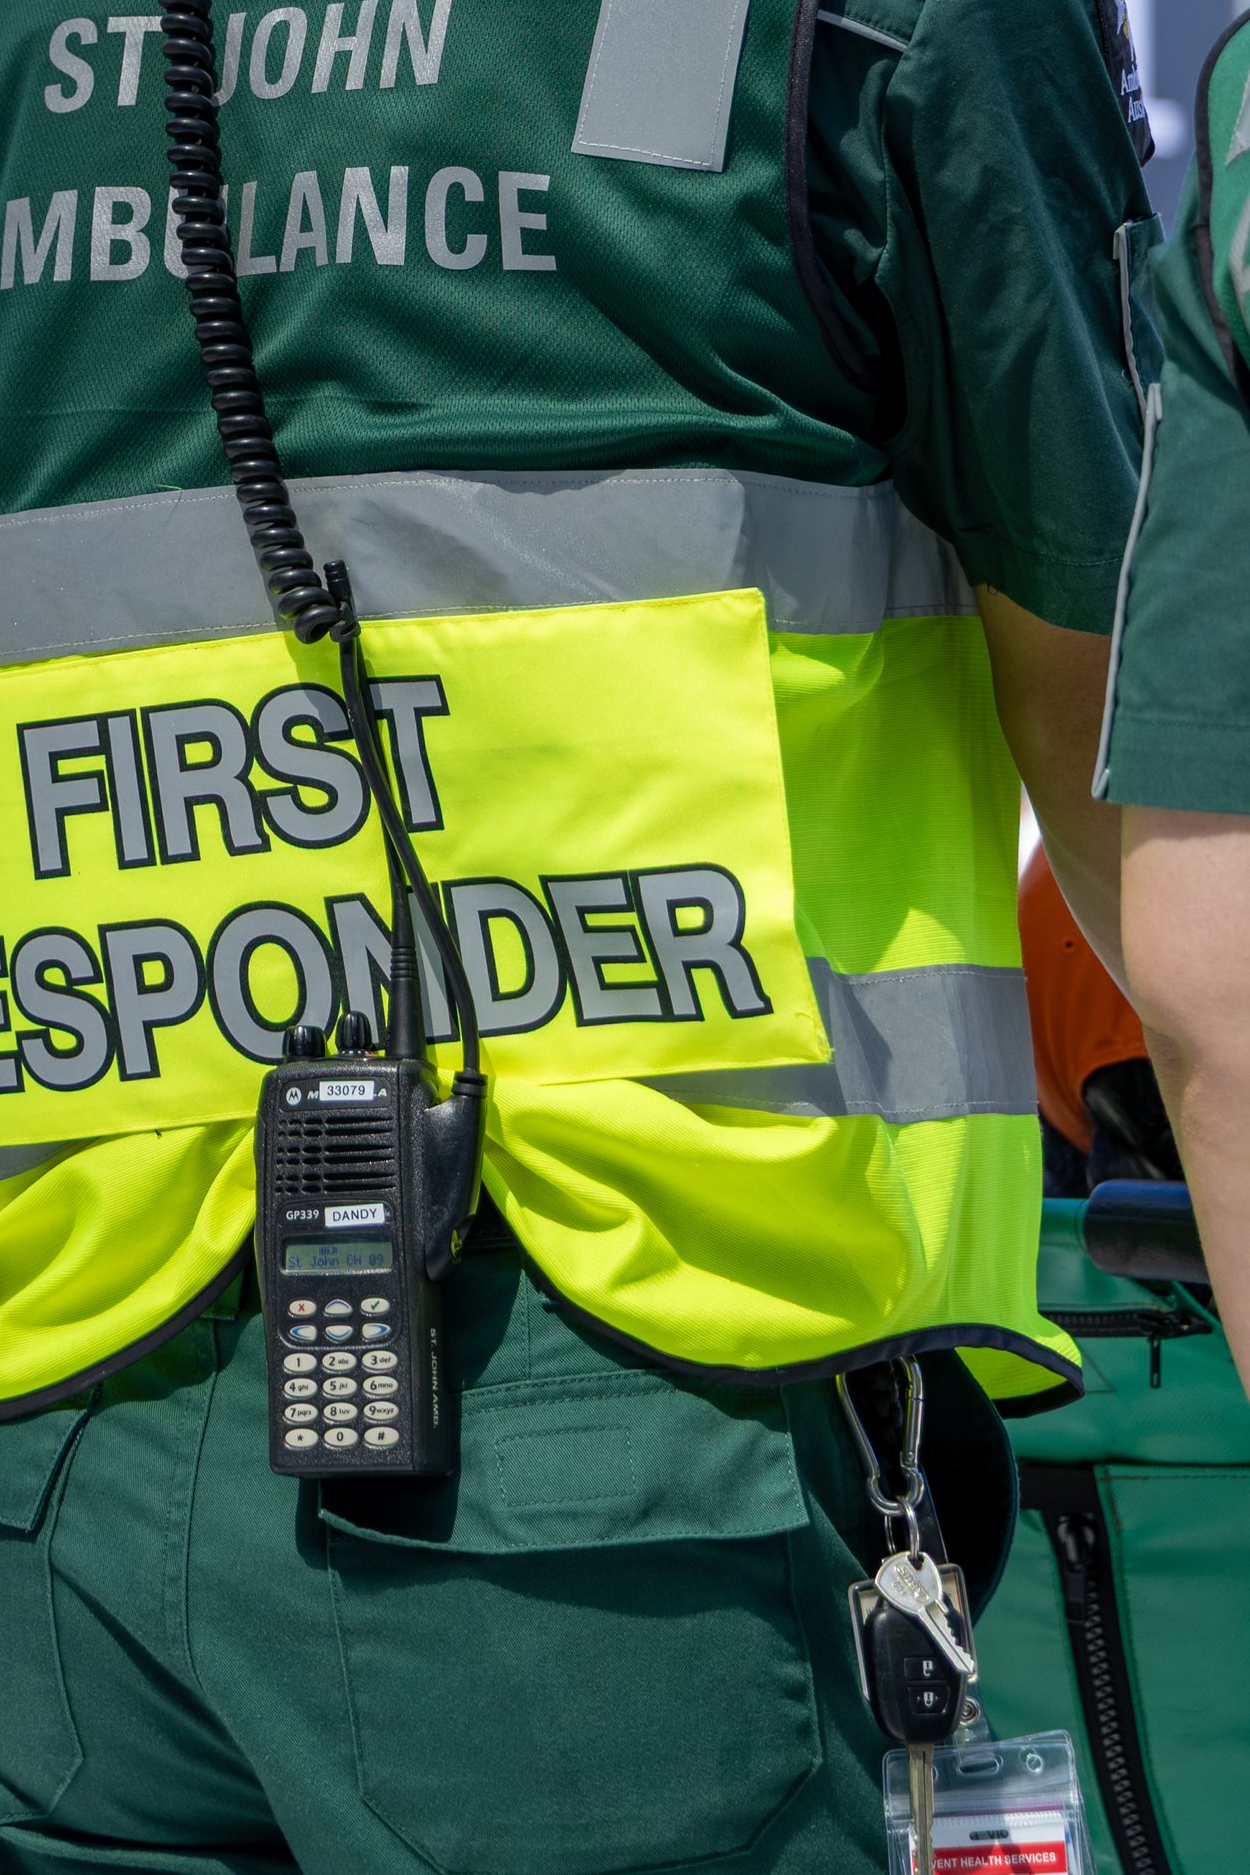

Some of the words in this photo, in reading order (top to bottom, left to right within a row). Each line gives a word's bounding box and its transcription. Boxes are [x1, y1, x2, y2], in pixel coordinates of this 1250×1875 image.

[44, 15, 168, 114] ST
[16, 674, 451, 880] FIRST
[326, 1084, 366, 1097] 33079
[285, 1209, 320, 1221] GP339
[332, 1208, 378, 1222] DANDY
[310, 1255, 339, 1267] John
[328, 1356, 336, 1366] 2
[370, 1355, 378, 1366] 3
[289, 1382, 296, 1392] 4
[329, 1380, 336, 1391] 5
[370, 1379, 377, 1390] 6
[290, 1408, 296, 1418] 7
[330, 1406, 337, 1416] 8
[369, 1405, 376, 1415] 9
[932, 1857, 958, 1869] VENT
[960, 1855, 1002, 1867] HEALTH
[1004, 1851, 1057, 1865] SERVICES
